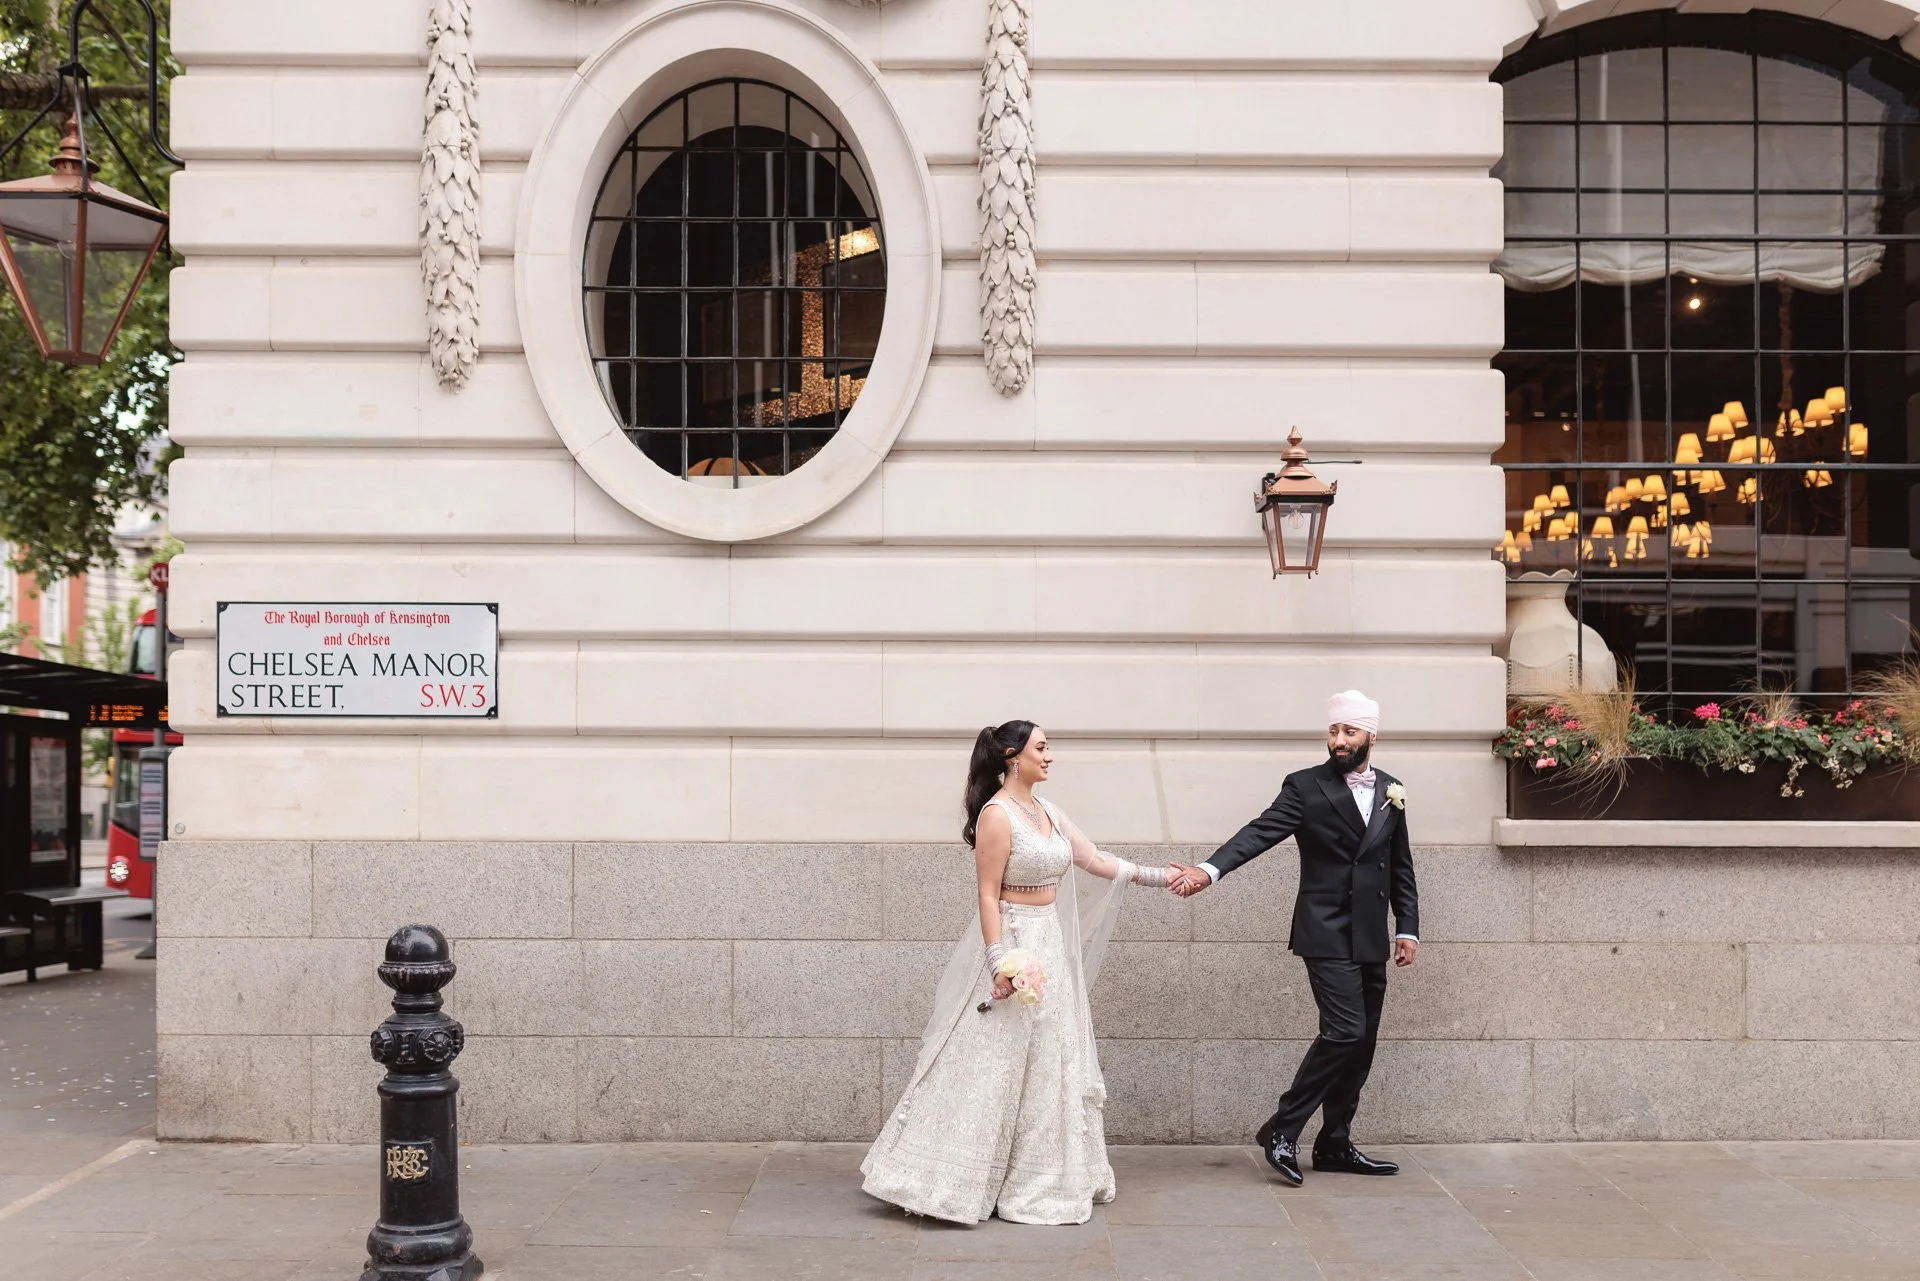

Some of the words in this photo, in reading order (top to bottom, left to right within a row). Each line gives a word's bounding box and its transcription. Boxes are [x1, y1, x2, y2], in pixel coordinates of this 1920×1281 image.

[265, 611, 285, 624] The
[289, 611, 320, 628] Royal
[325, 611, 370, 627] Borough
[374, 611, 386, 624] of
[390, 611, 450, 628] Kensington
[324, 633, 342, 646] and
[347, 633, 390, 646] Chelsea
[228, 652, 358, 677] CHELSEA
[372, 653, 489, 677] MANOR
[420, 684, 486, 708] S.W.3
